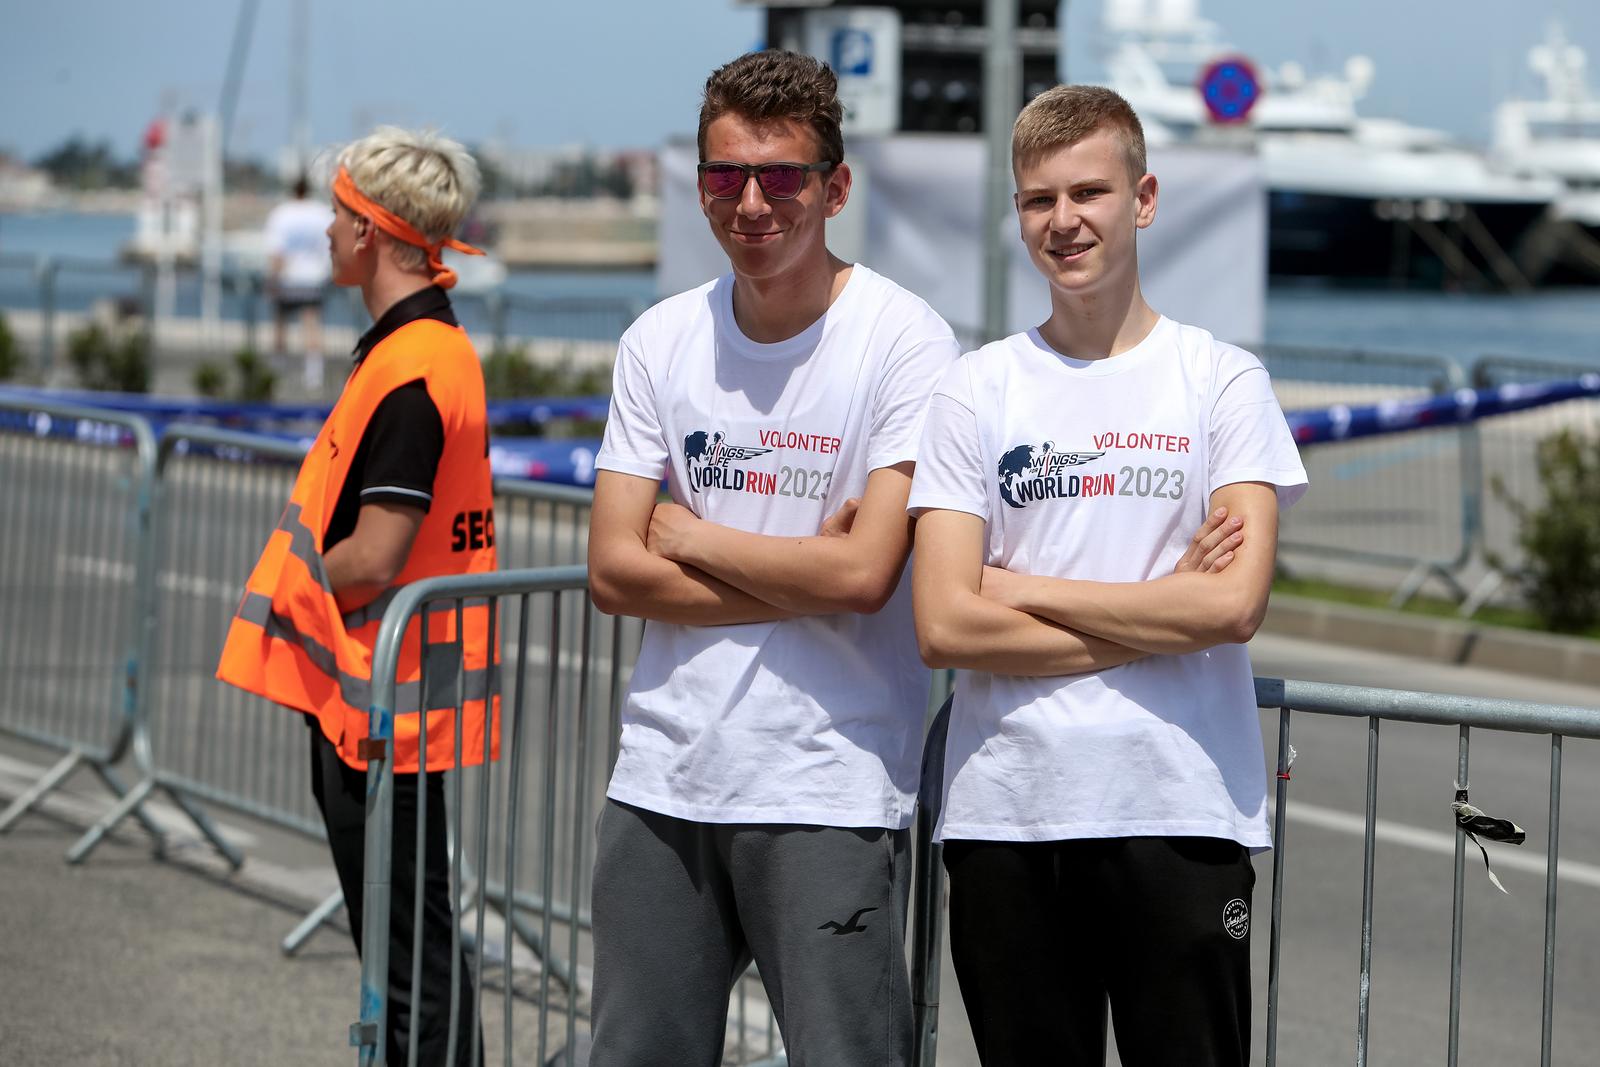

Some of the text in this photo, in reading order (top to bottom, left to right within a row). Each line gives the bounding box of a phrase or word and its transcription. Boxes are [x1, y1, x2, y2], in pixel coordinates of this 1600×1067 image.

[759, 429, 841, 454] VOLONTER
[1093, 431, 1191, 453] VOLONTER
[1031, 453, 1080, 469] WINGS
[1037, 465, 1065, 478] LIFE
[1016, 465, 1186, 503] WORLD RUN 2023
